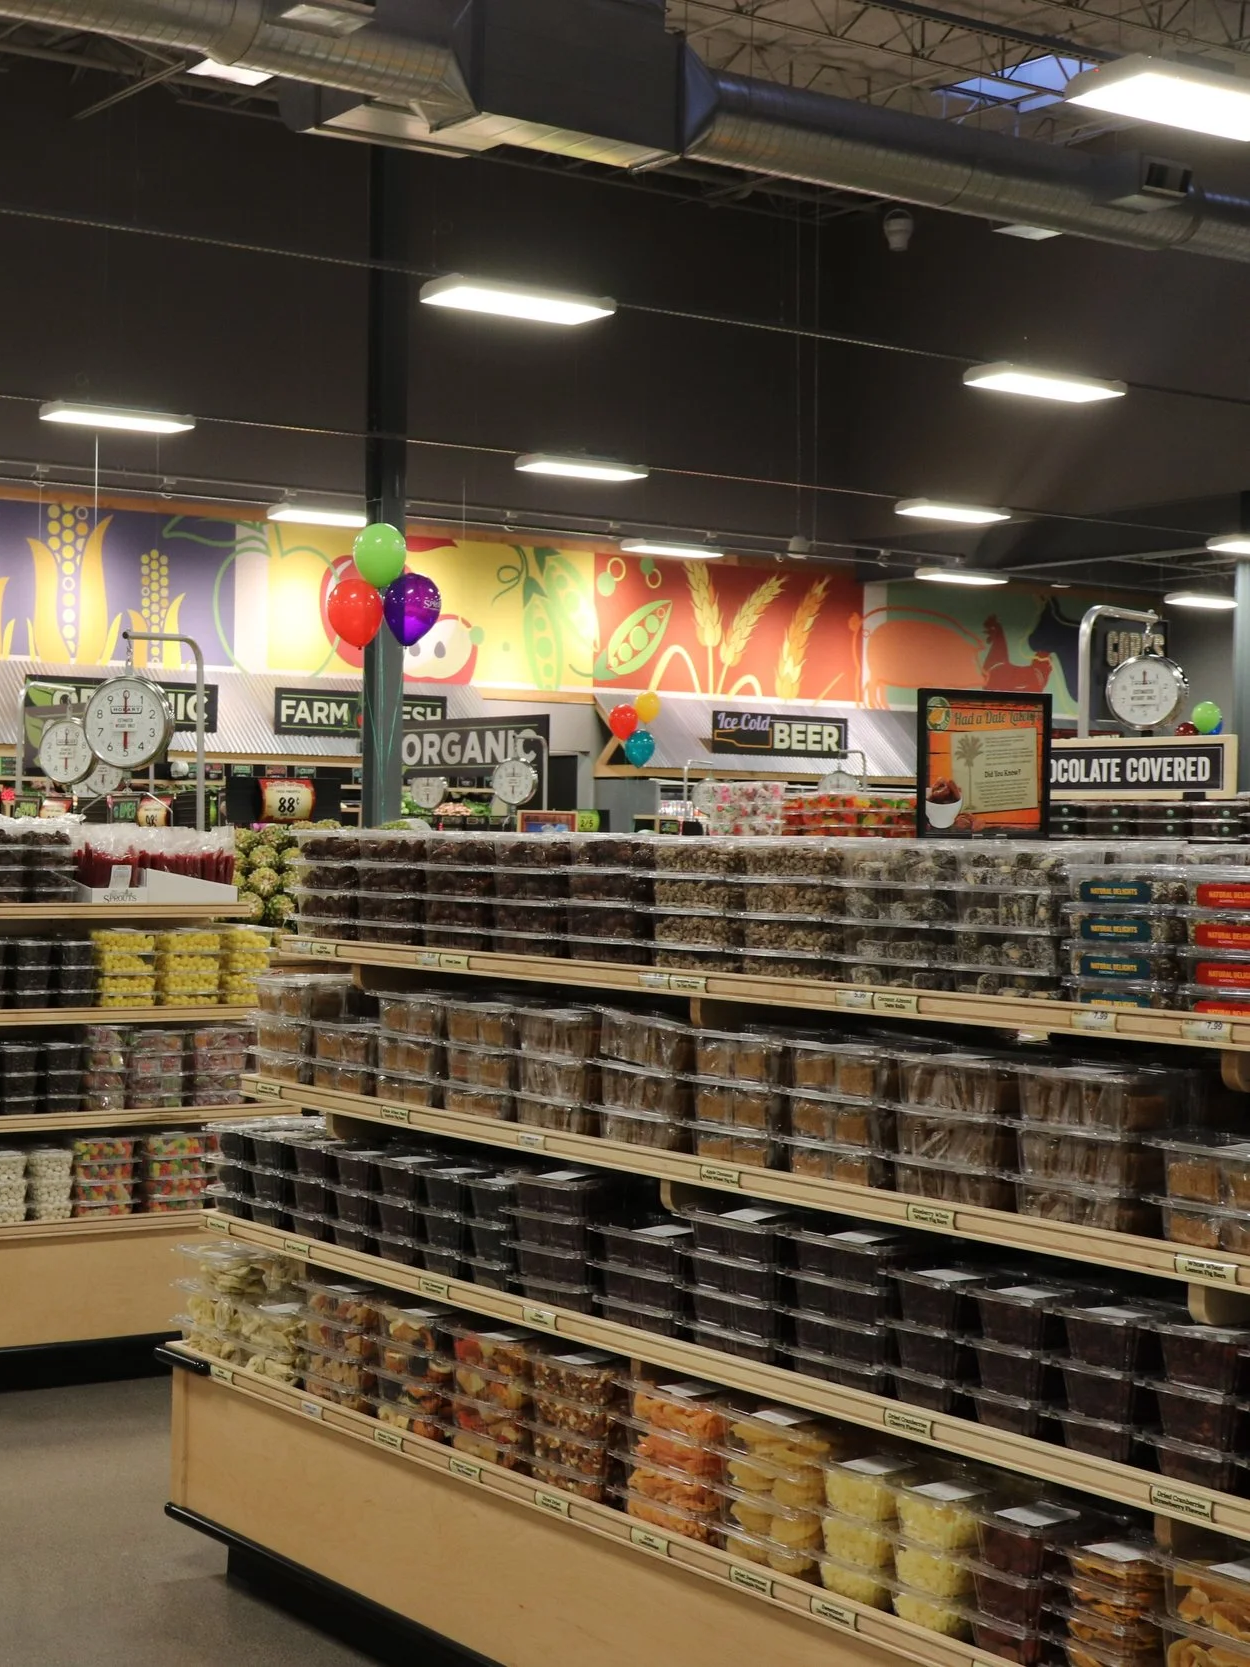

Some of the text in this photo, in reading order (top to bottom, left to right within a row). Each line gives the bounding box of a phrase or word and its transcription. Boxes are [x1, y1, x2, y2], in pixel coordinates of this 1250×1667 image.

[96, 710, 103, 719] 8
[150, 710, 156, 719] 2
[281, 700, 348, 724] FARM
[718, 712, 772, 731] Ice Cold
[954, 712, 974, 726] Had
[976, 715, 982, 724] a
[986, 712, 1006, 724] Date
[98, 728, 104, 737] 7
[150, 728, 156, 738] 3
[774, 722, 840, 752] BEER
[107, 742, 114, 752] 6
[138, 742, 144, 751] 4
[402, 728, 538, 766] ORGANIC
[1050, 756, 1210, 782] OCOLATE COVERED
[1094, 1012, 1108, 1020] 7.99
[1207, 1022, 1222, 1030] 7.99
[1206, 1262, 1224, 1271] Wheat
[1205, 1269, 1213, 1277] Fig
[1157, 1490, 1205, 1509] Dried Cranberries
[1153, 1497, 1209, 1518] Strawberry Flavored
